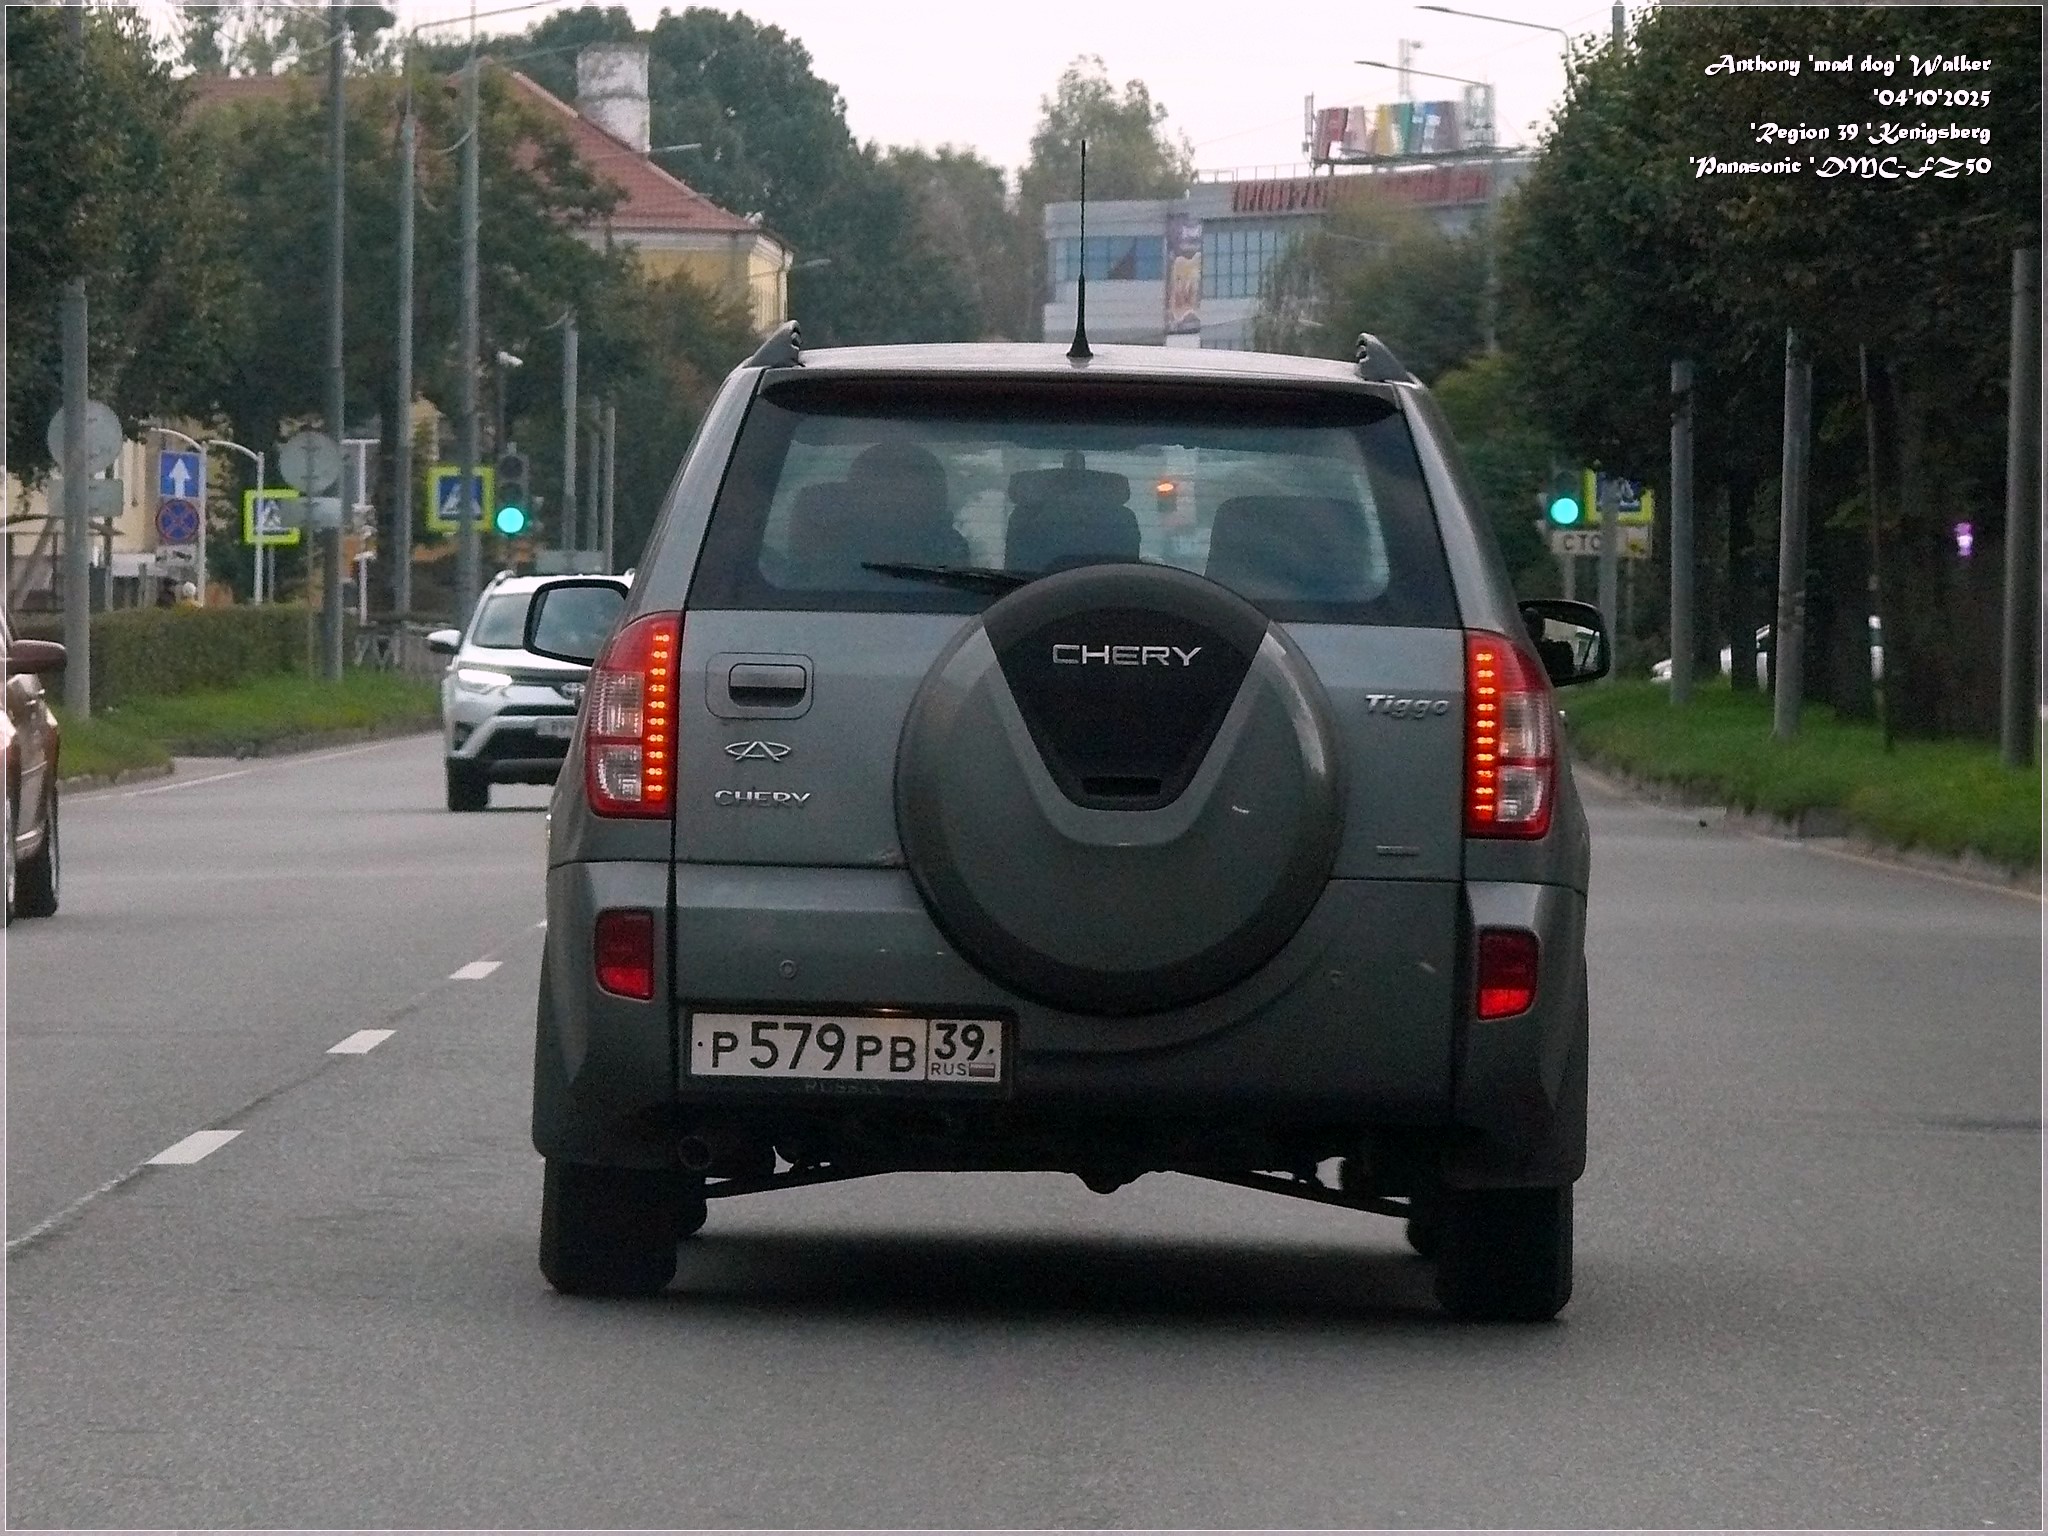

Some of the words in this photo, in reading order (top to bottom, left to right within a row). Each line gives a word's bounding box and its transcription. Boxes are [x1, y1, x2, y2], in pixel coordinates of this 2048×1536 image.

[1052, 643, 1203, 668] CHERY
[1364, 693, 1450, 720] Tiggo
[714, 789, 812, 808] CHERY
[933, 1022, 985, 1062] 39
[930, 1062, 968, 1078] RUS
